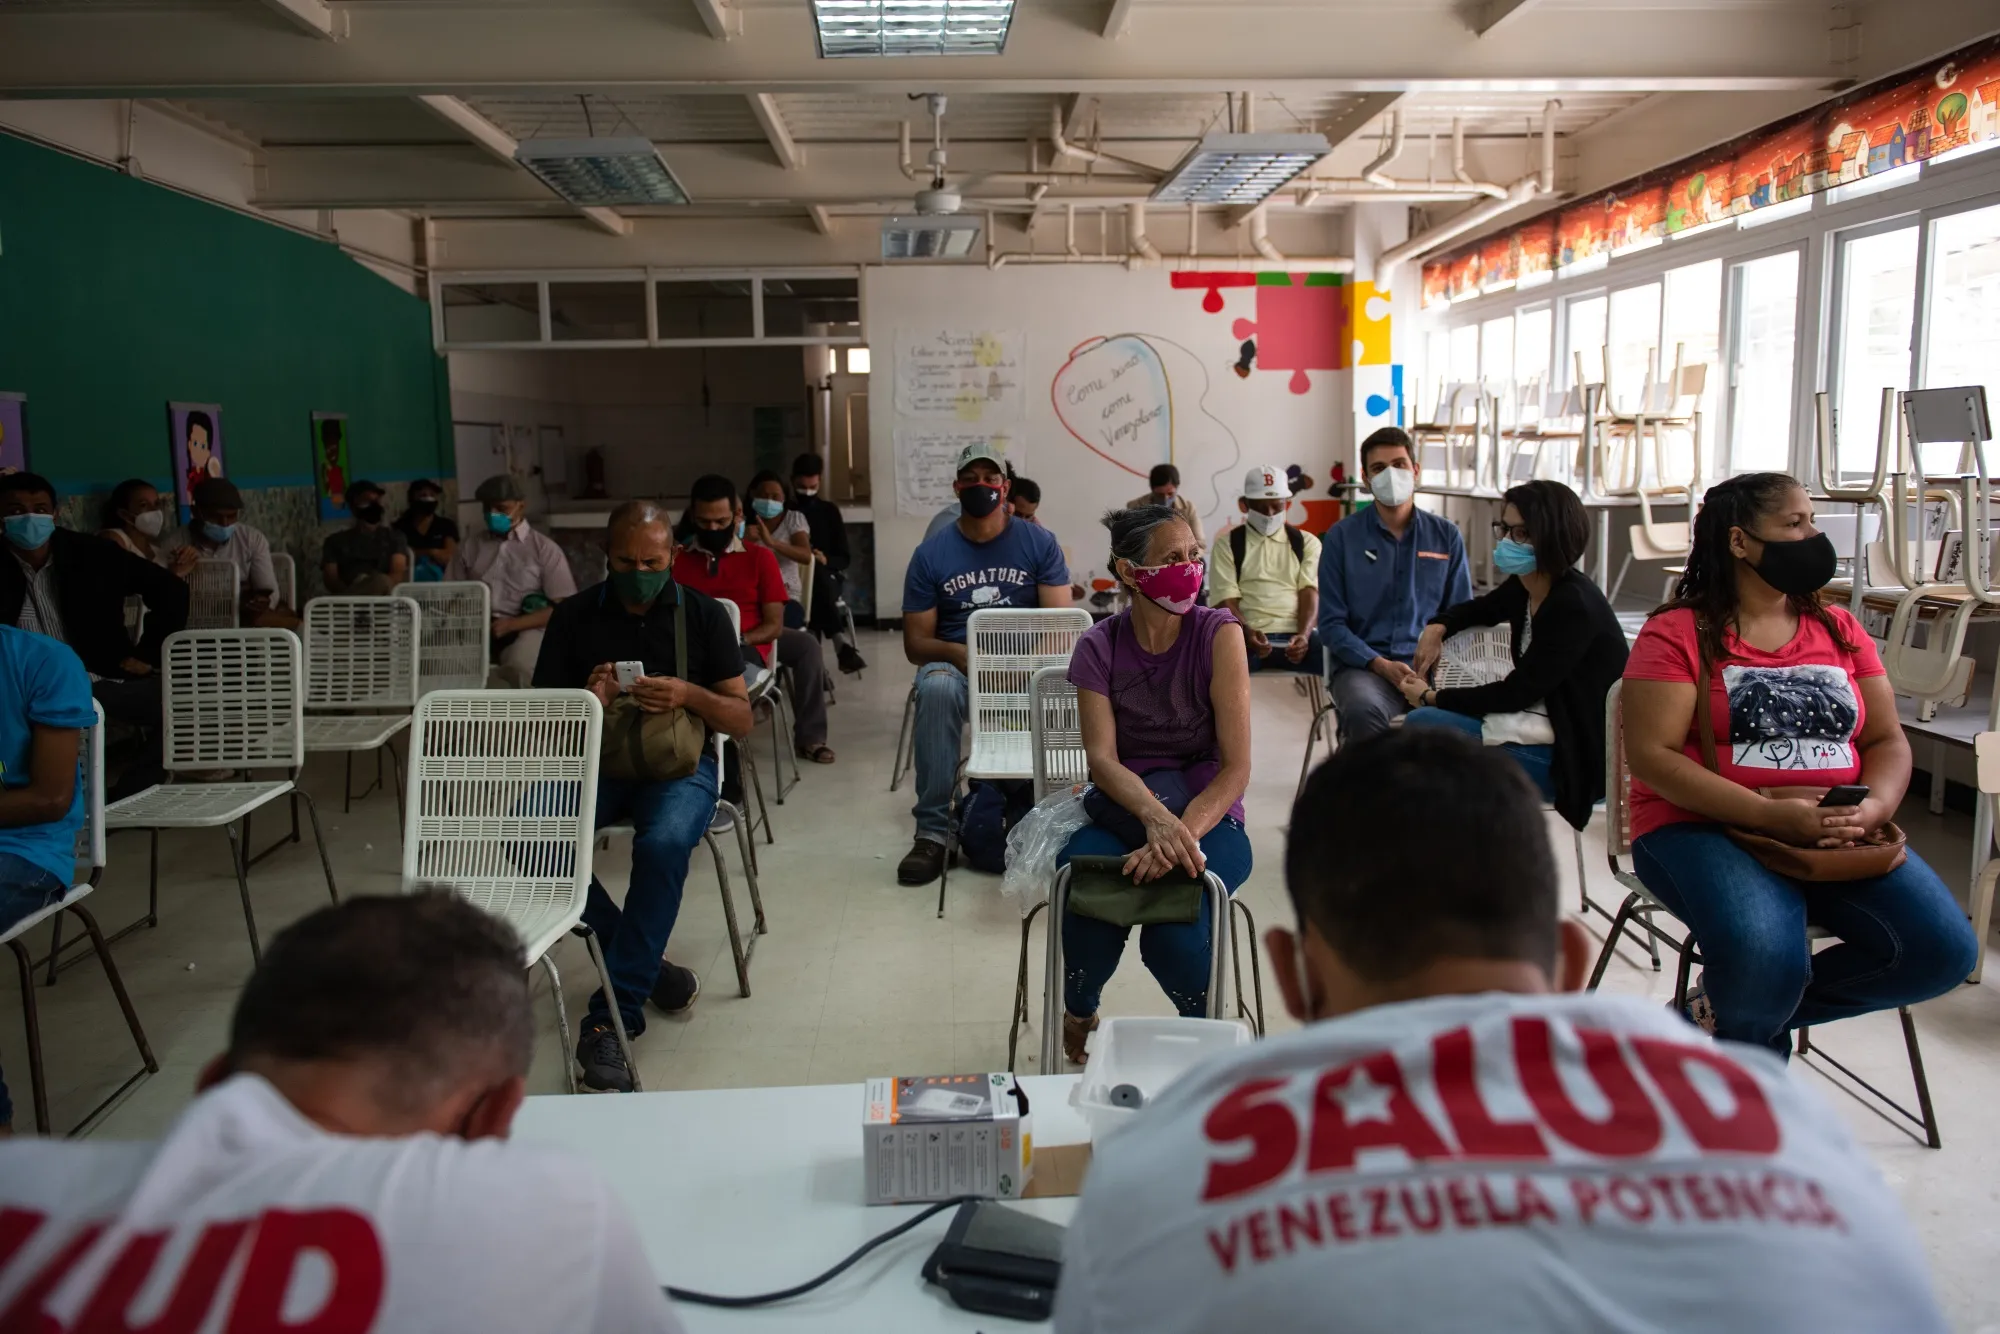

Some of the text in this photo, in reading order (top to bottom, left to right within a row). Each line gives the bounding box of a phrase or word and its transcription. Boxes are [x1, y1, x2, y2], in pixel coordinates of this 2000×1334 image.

[1066, 379, 1106, 405] Come
[1264, 474, 1274, 486] B
[943, 567, 1028, 596] SIGNATURE
[1203, 1015, 1781, 1200] SALUD
[1206, 1175, 1557, 1274] VENEZUELA
